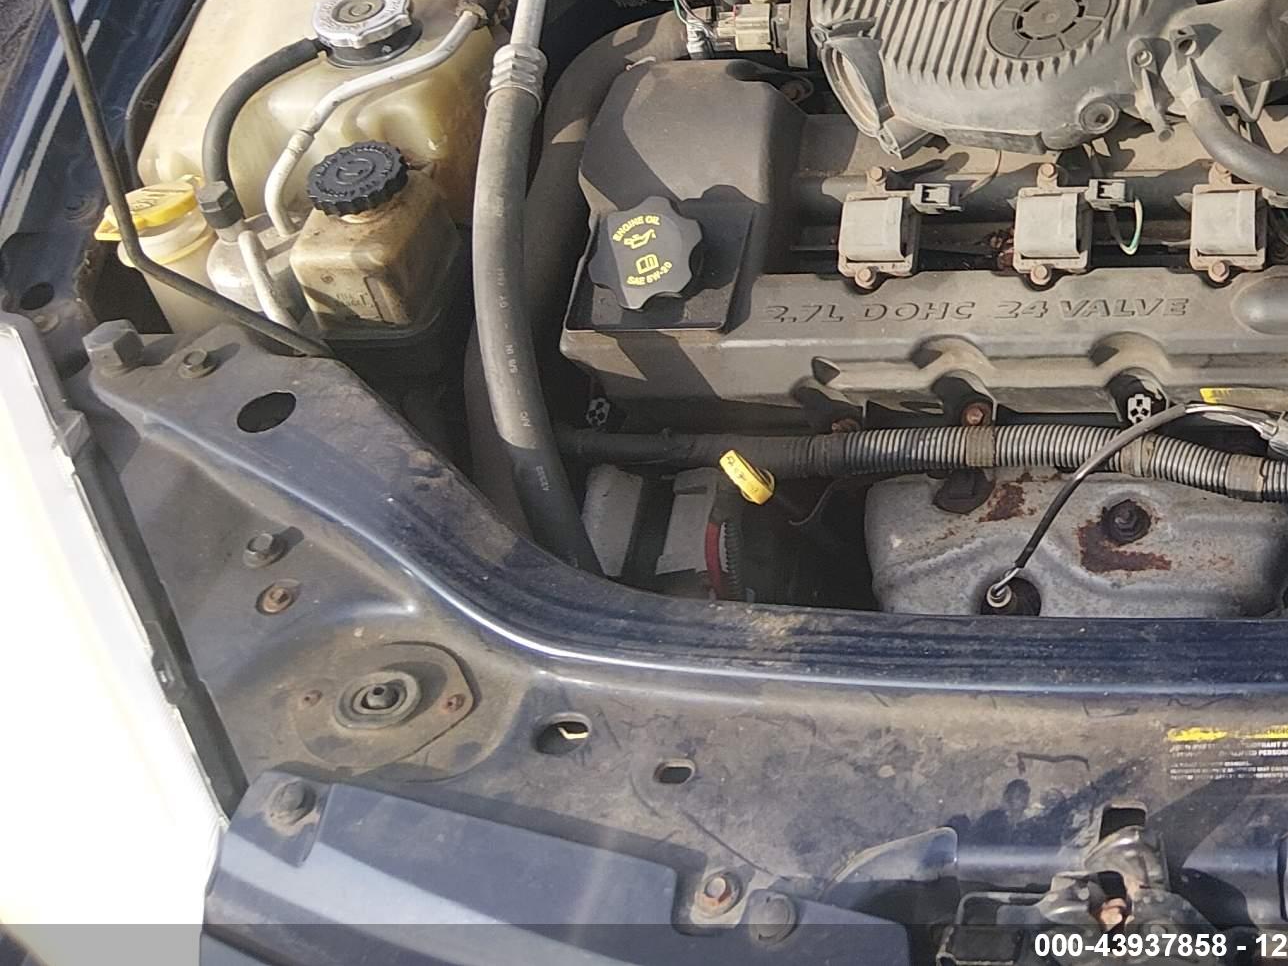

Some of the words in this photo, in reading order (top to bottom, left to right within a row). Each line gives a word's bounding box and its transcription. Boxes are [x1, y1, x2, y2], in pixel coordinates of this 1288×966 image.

[612, 215, 645, 242] ENGINE
[644, 215, 661, 226] OIL
[626, 275, 646, 286] SAE
[764, 304, 844, 323] 2.7L
[857, 301, 976, 323] DOHC
[993, 299, 1049, 321] 24
[1057, 297, 1190, 319] VALVE
